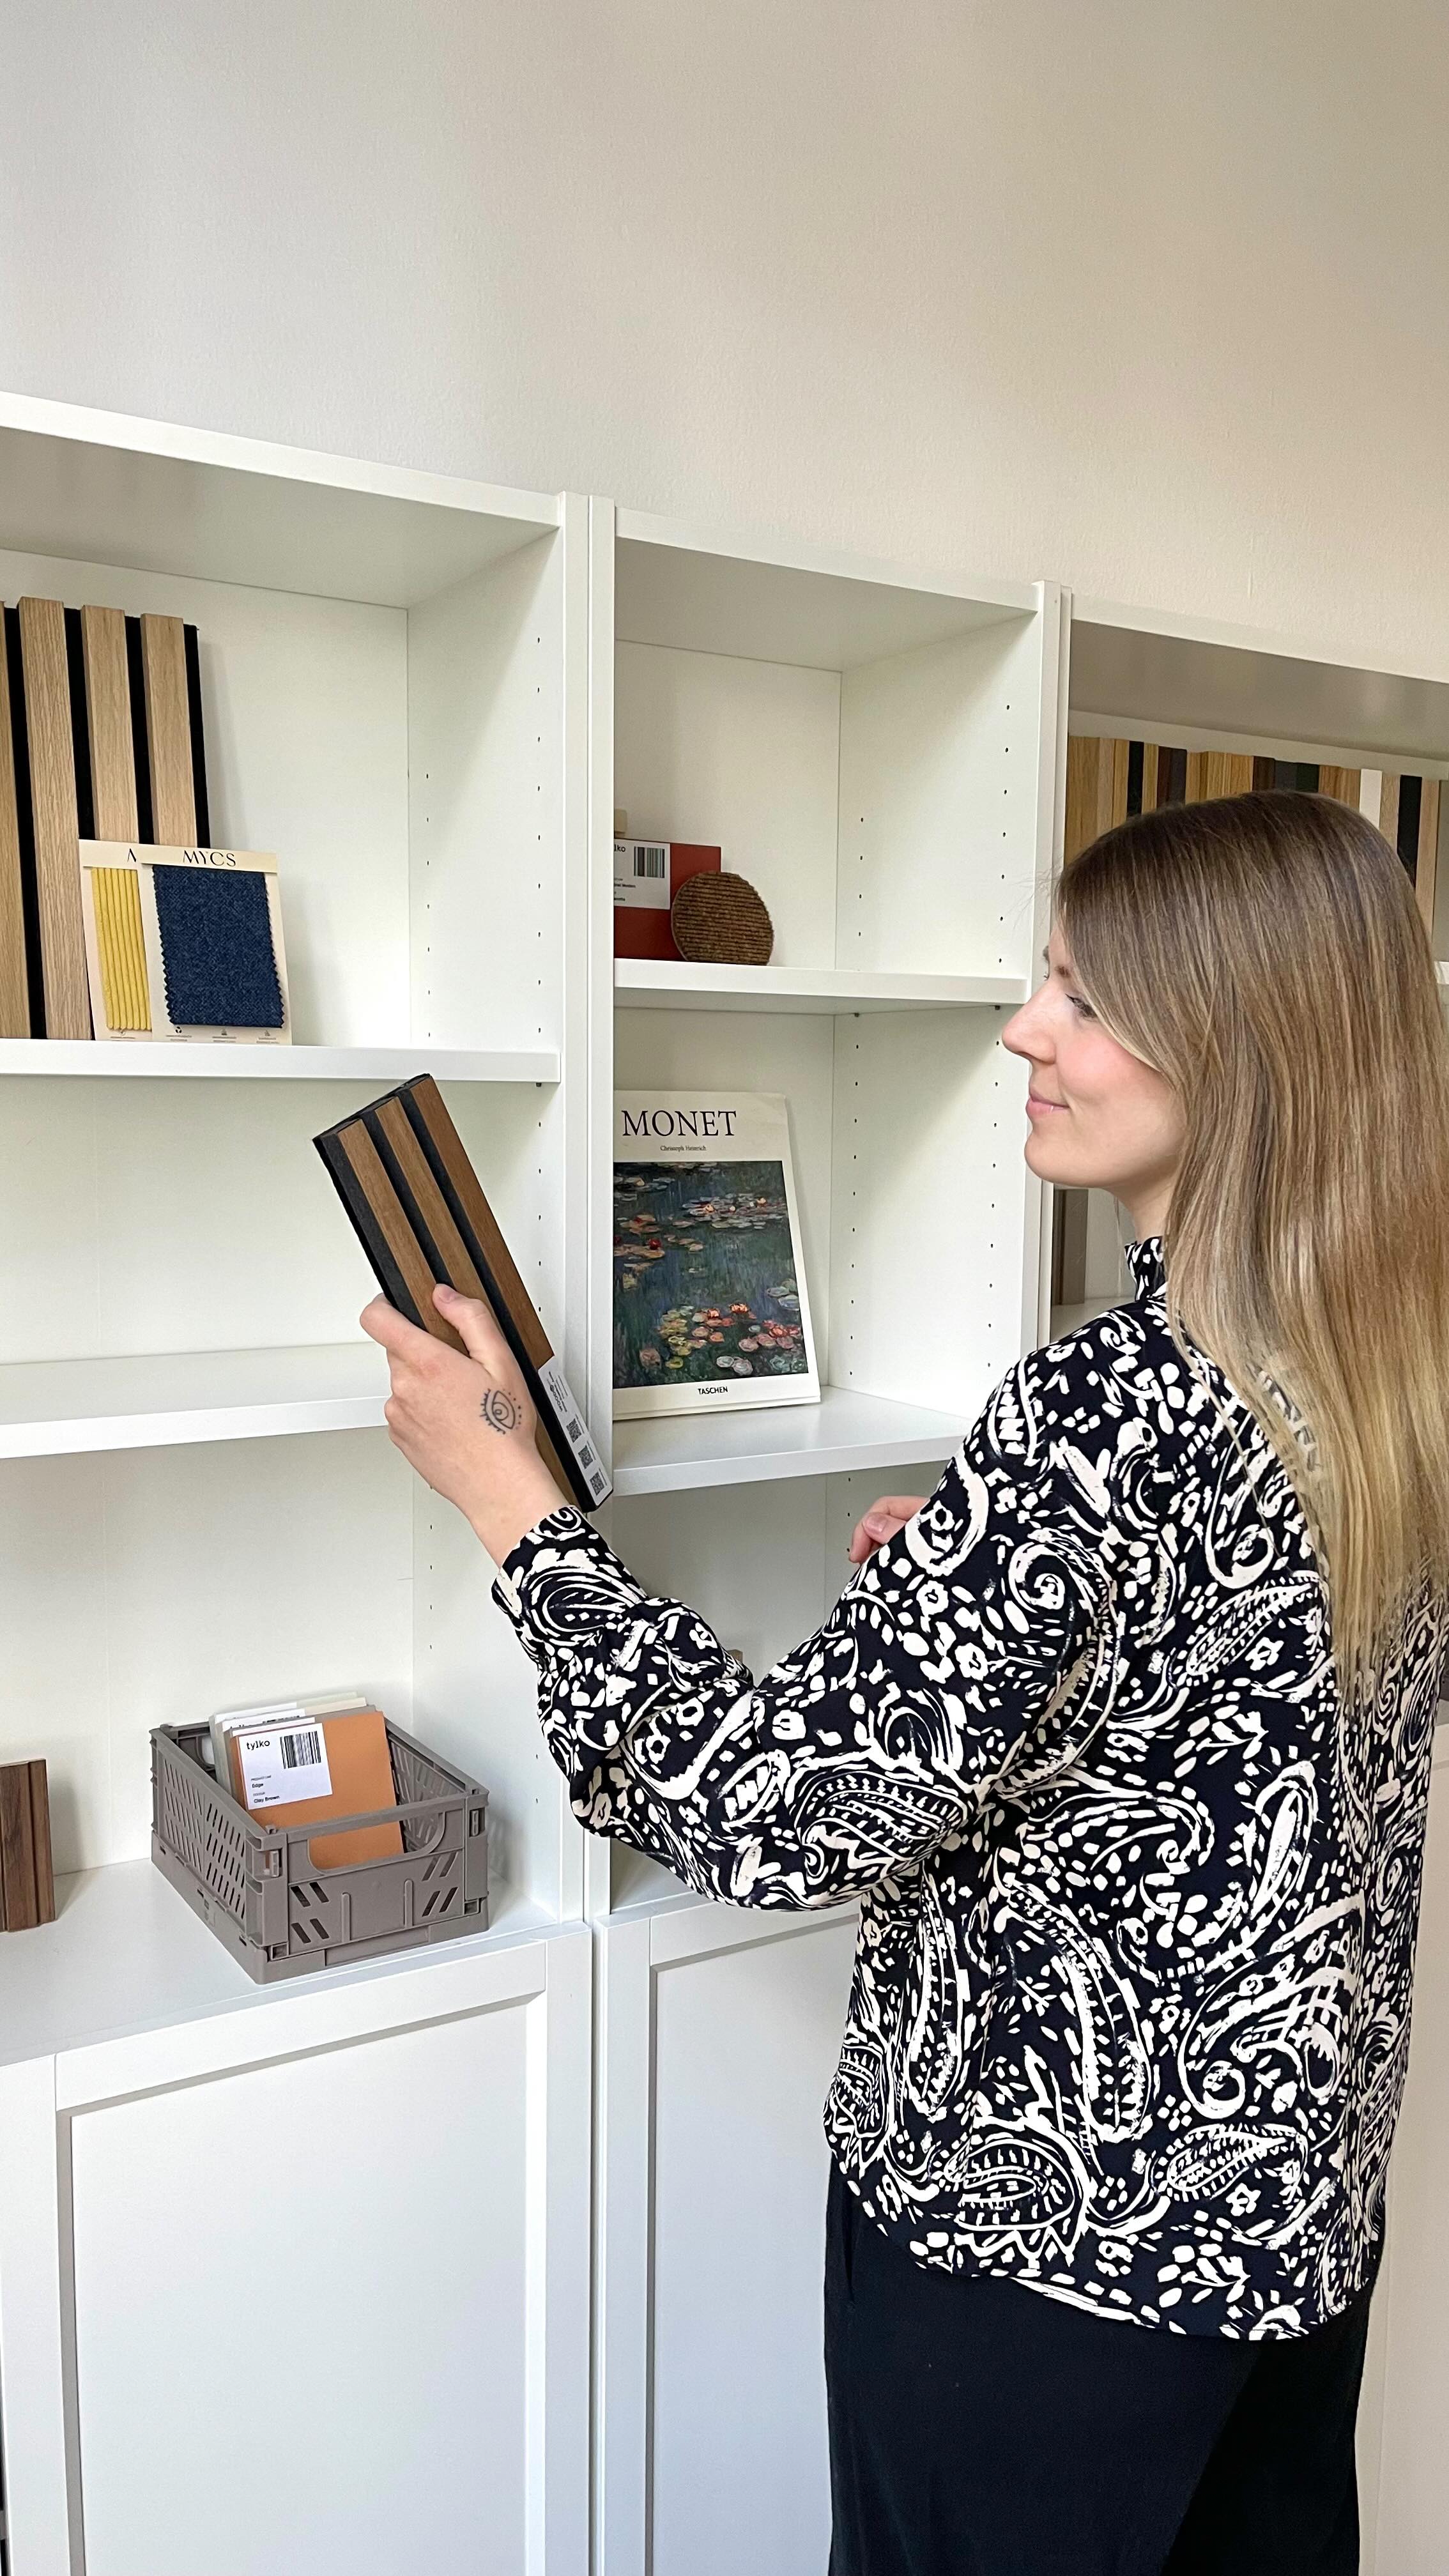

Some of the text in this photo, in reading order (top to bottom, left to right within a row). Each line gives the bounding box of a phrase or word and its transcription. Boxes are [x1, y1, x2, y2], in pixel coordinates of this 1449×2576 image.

[614, 844, 625, 852] lko
[183, 850, 236, 867] MYCS
[622, 1110, 737, 1137] MONET
[698, 1386, 728, 1395] TASCHEN
[247, 1740, 270, 1751] tylko
